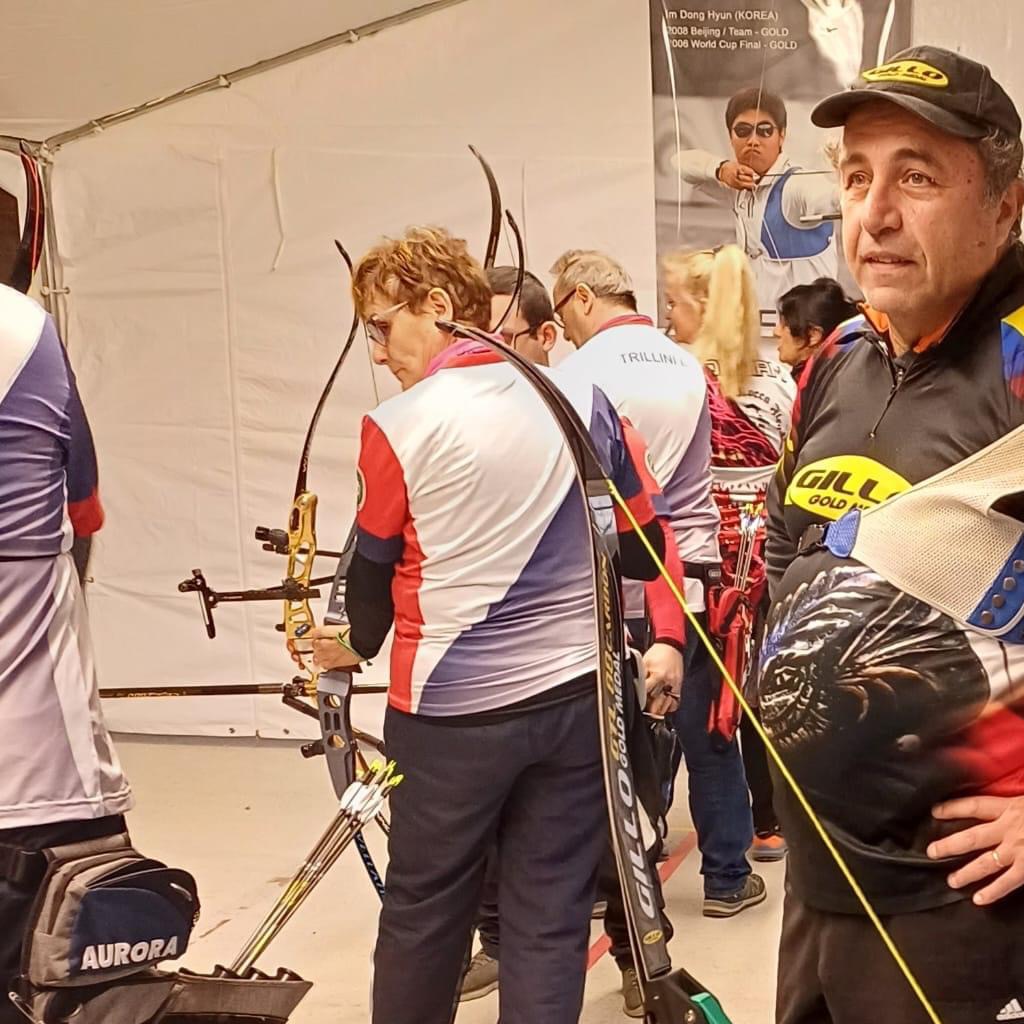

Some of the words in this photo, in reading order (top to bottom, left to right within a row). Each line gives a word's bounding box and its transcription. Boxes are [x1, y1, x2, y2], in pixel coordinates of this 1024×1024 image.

[680, 9, 705, 21] Dong
[707, 10, 733, 21] Hyun
[734, 9, 779, 21] (KOREA)
[690, 26, 721, 38] Beijing
[729, 27, 753, 37] Team
[760, 27, 789, 37] GOLD
[670, 39, 689, 49] 006
[690, 39, 716, 49] World
[718, 39, 738, 50] Cup
[739, 40, 761, 50] Final
[769, 40, 798, 50] GOLD
[796, 469, 902, 505] GILL
[808, 494, 848, 510] GOLD
[611, 651, 622, 713] MEDAL
[617, 716, 629, 769] GOLD
[617, 768, 656, 919] GILLO
[80, 935, 178, 970] AURORA
